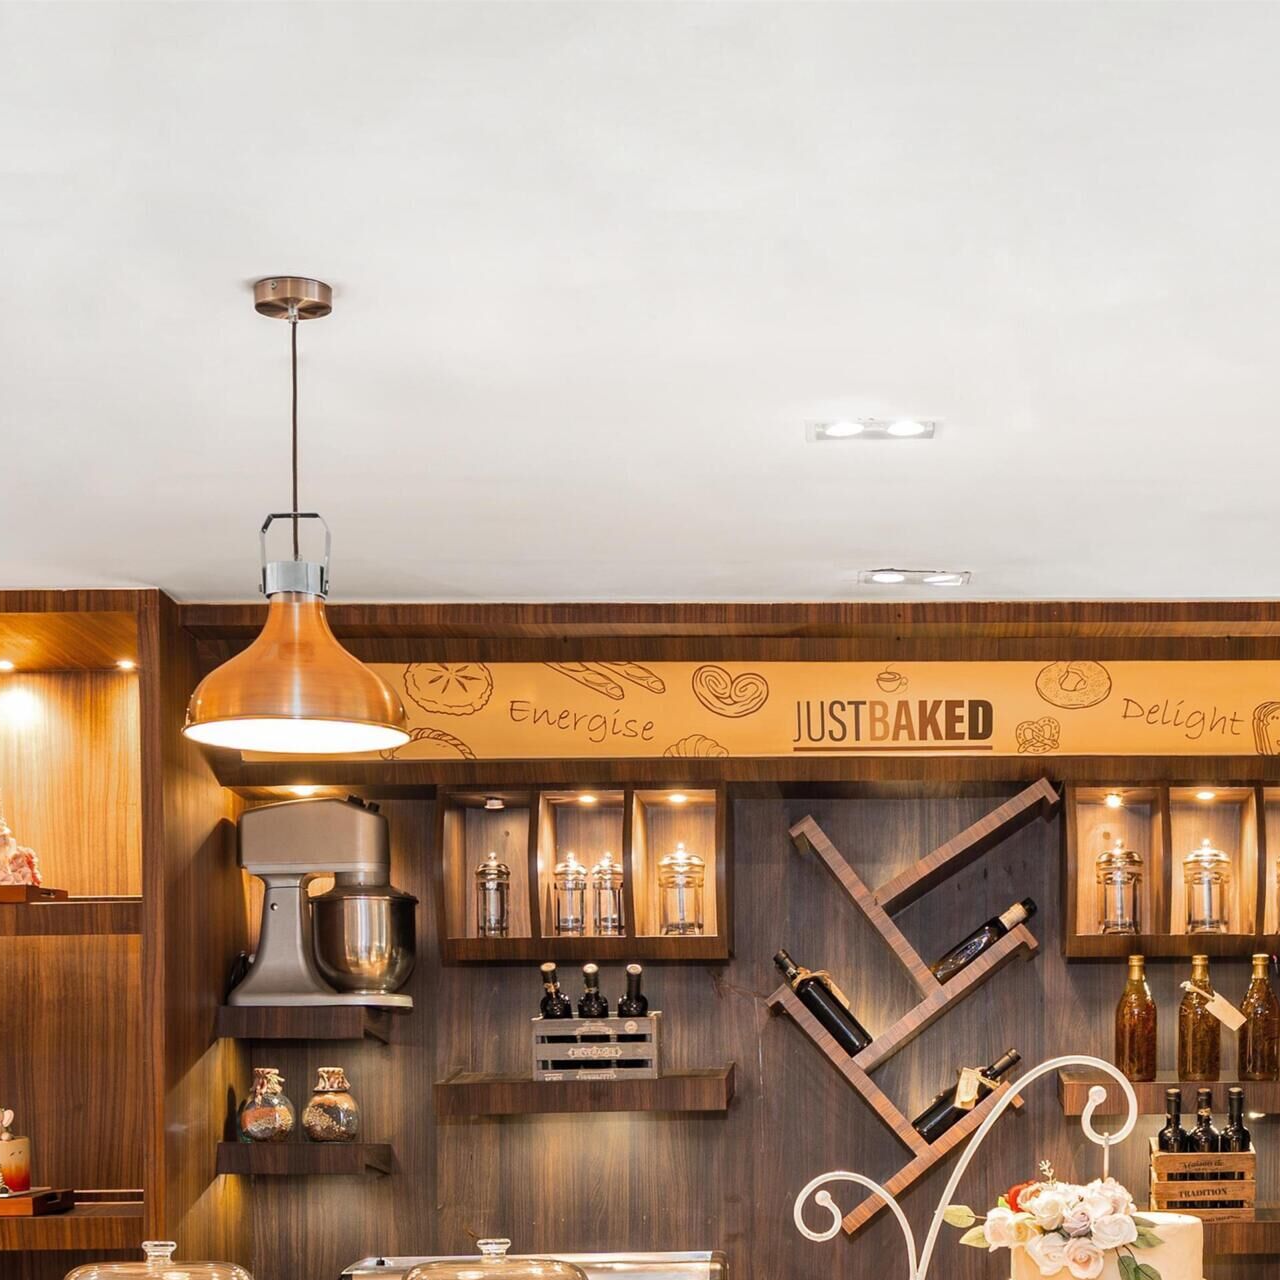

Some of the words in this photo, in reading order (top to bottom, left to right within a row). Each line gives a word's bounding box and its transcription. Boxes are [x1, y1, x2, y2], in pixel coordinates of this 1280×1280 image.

[509, 700, 654, 742] Energise
[1121, 697, 1245, 740] Delight
[1179, 1187, 1228, 1198] TRADITION
